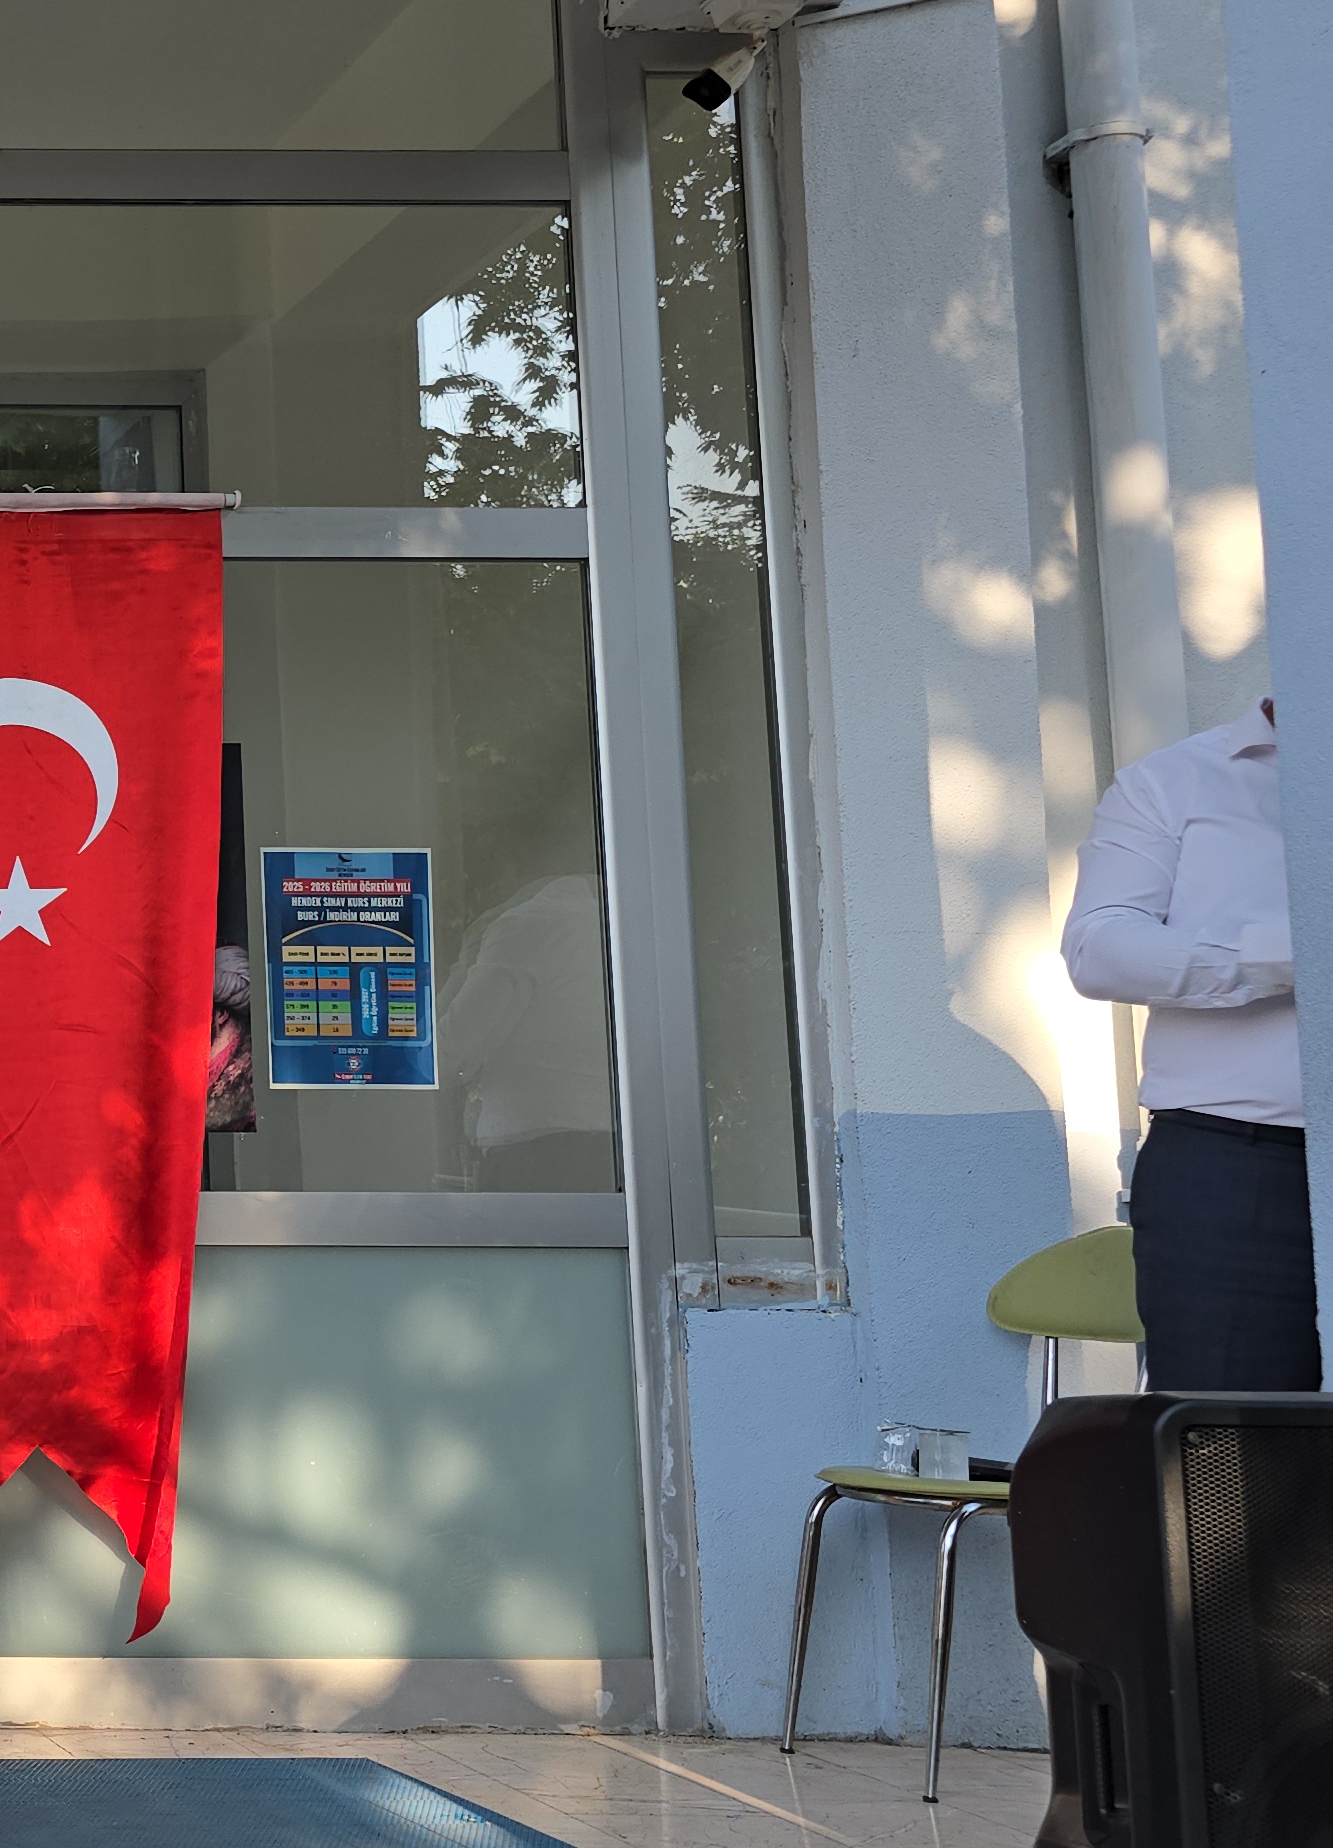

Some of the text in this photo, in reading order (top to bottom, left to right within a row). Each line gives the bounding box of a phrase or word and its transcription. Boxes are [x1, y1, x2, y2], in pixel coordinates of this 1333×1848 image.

[332, 880, 357, 892] EĞİTİM
[360, 880, 394, 892] ÖĞRETİM
[397, 882, 411, 892] YILI
[292, 897, 321, 907] HENDEK
[347, 897, 368, 907] KURS
[371, 895, 404, 907] MERKEZİ
[297, 911, 319, 921] BURS
[326, 909, 357, 921] İNDİRİM
